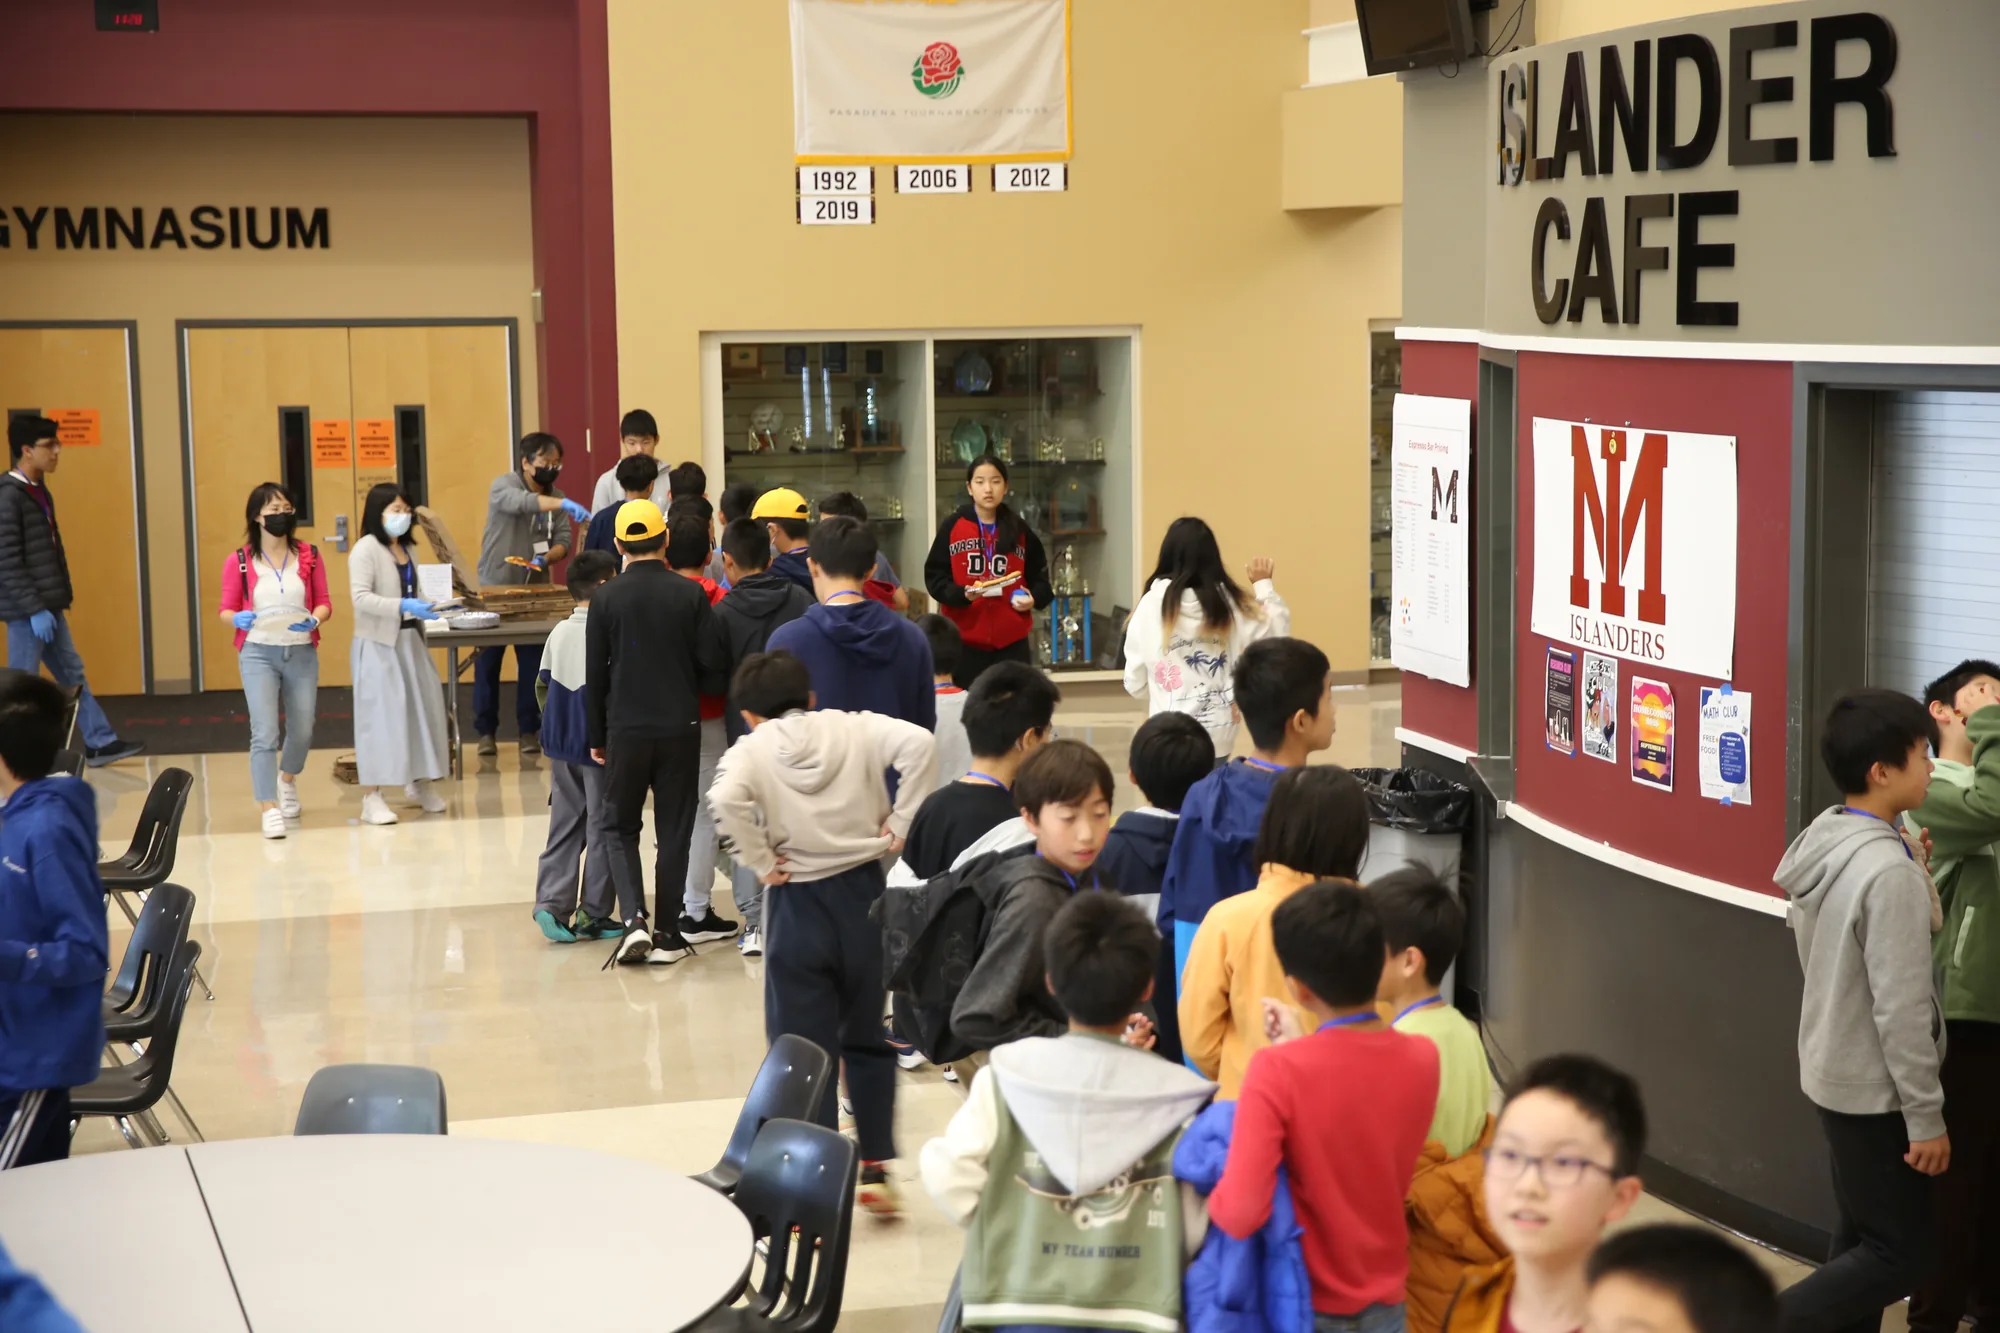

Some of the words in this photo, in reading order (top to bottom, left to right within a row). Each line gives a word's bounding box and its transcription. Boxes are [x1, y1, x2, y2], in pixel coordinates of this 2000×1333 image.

[1496, 11, 1898, 187] ISLANDER
[829, 108, 897, 117] PASADENA
[903, 108, 988, 117] TOURNAMENT
[813, 171, 857, 191] 1992
[910, 169, 957, 188] 2006
[1010, 168, 1050, 187] 2012
[816, 201, 858, 220] 2019
[0, 206, 330, 251] YMNASIUM
[1531, 189, 1740, 327] CAFE
[1570, 614, 1665, 661] ISLANDERS
[1633, 704, 1671, 720] HOMECOMING
[1703, 707, 1719, 719] MATH
[1723, 705, 1738, 718] CLUB
[1703, 734, 1715, 743] FREE
[1701, 745, 1717, 755] FOOD!
[1042, 1242, 1059, 1255] MY
[1064, 1244, 1095, 1257] TEAM
[1098, 1245, 1141, 1258] NUMBER
